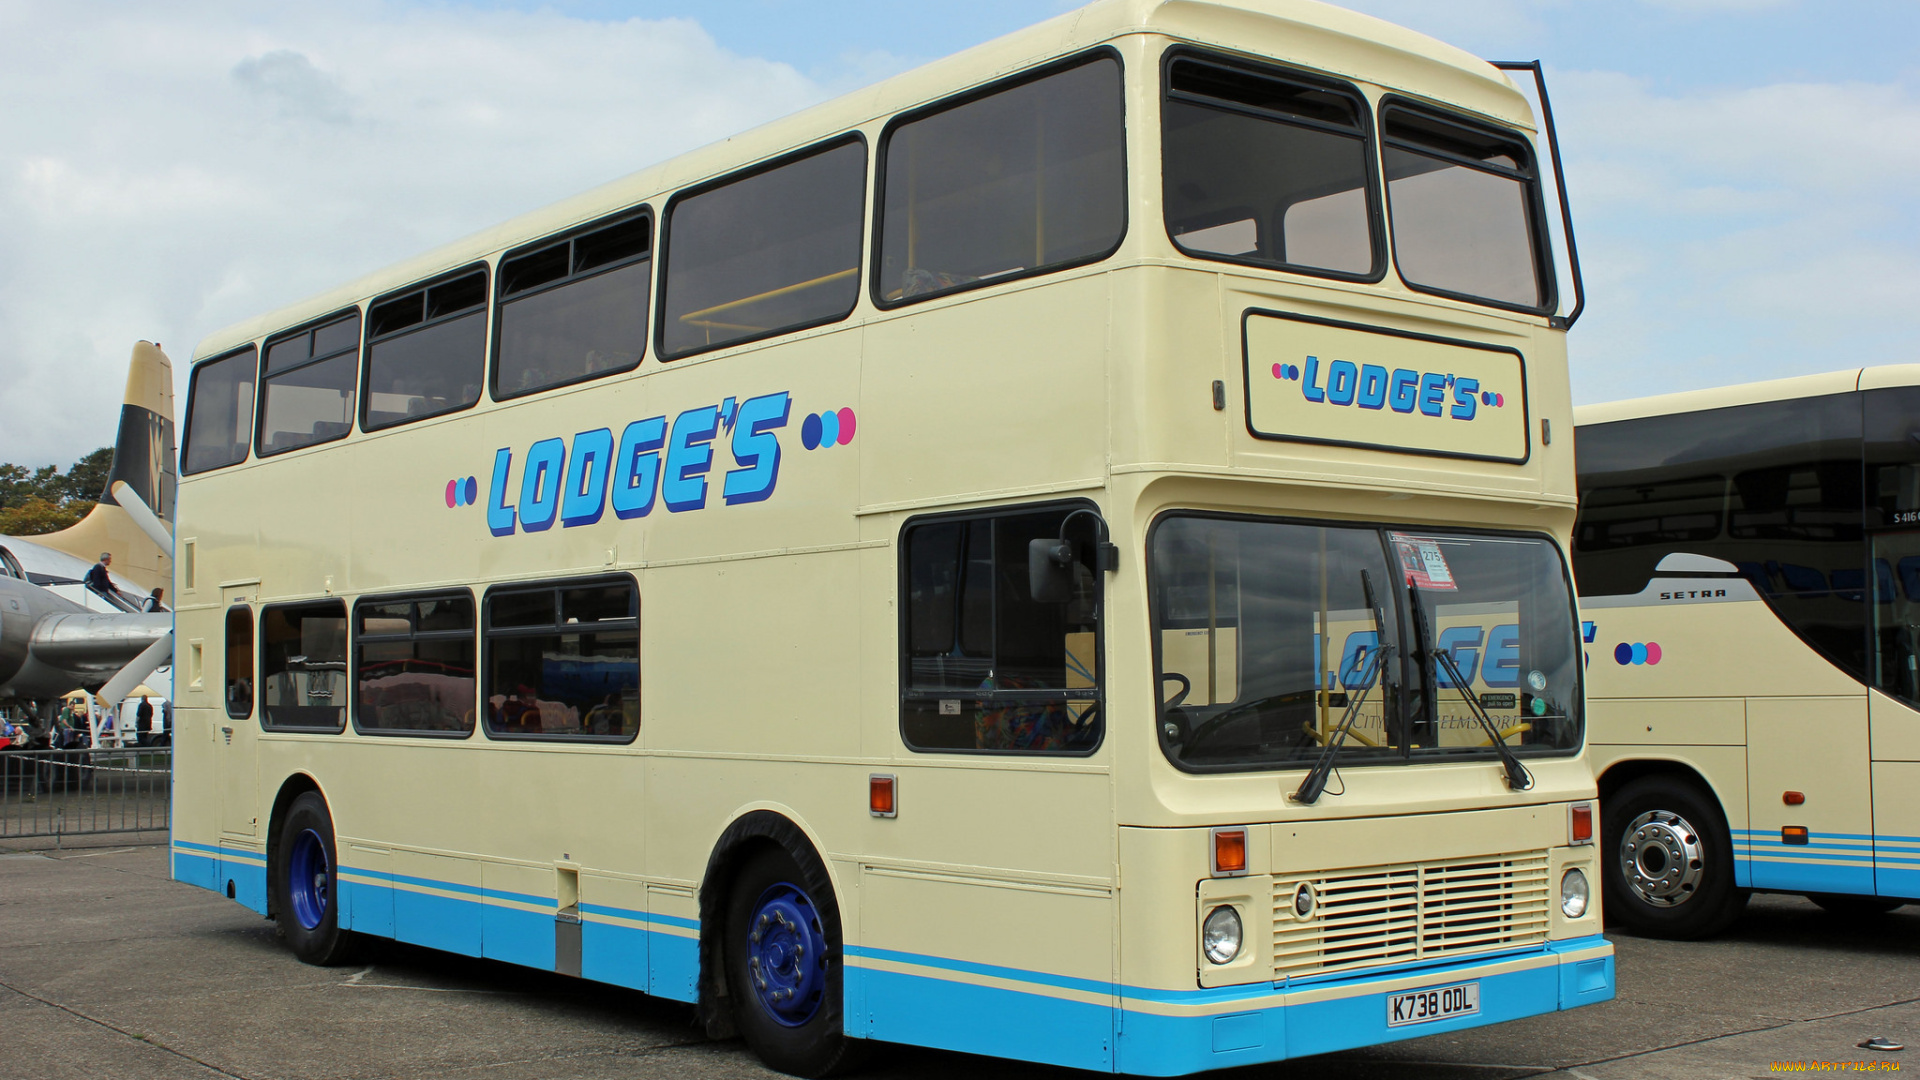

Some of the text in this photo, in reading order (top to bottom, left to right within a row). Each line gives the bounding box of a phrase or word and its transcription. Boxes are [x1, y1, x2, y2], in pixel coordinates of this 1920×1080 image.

[1302, 355, 1479, 421] LODGE'S
[487, 391, 792, 537] LODGE'S
[1894, 513, 1901, 523] S
[1901, 512, 1917, 522] 416
[1423, 550, 1441, 562] 275
[1660, 589, 1727, 600] SETRA
[1393, 987, 1473, 1021] K738 ODL
